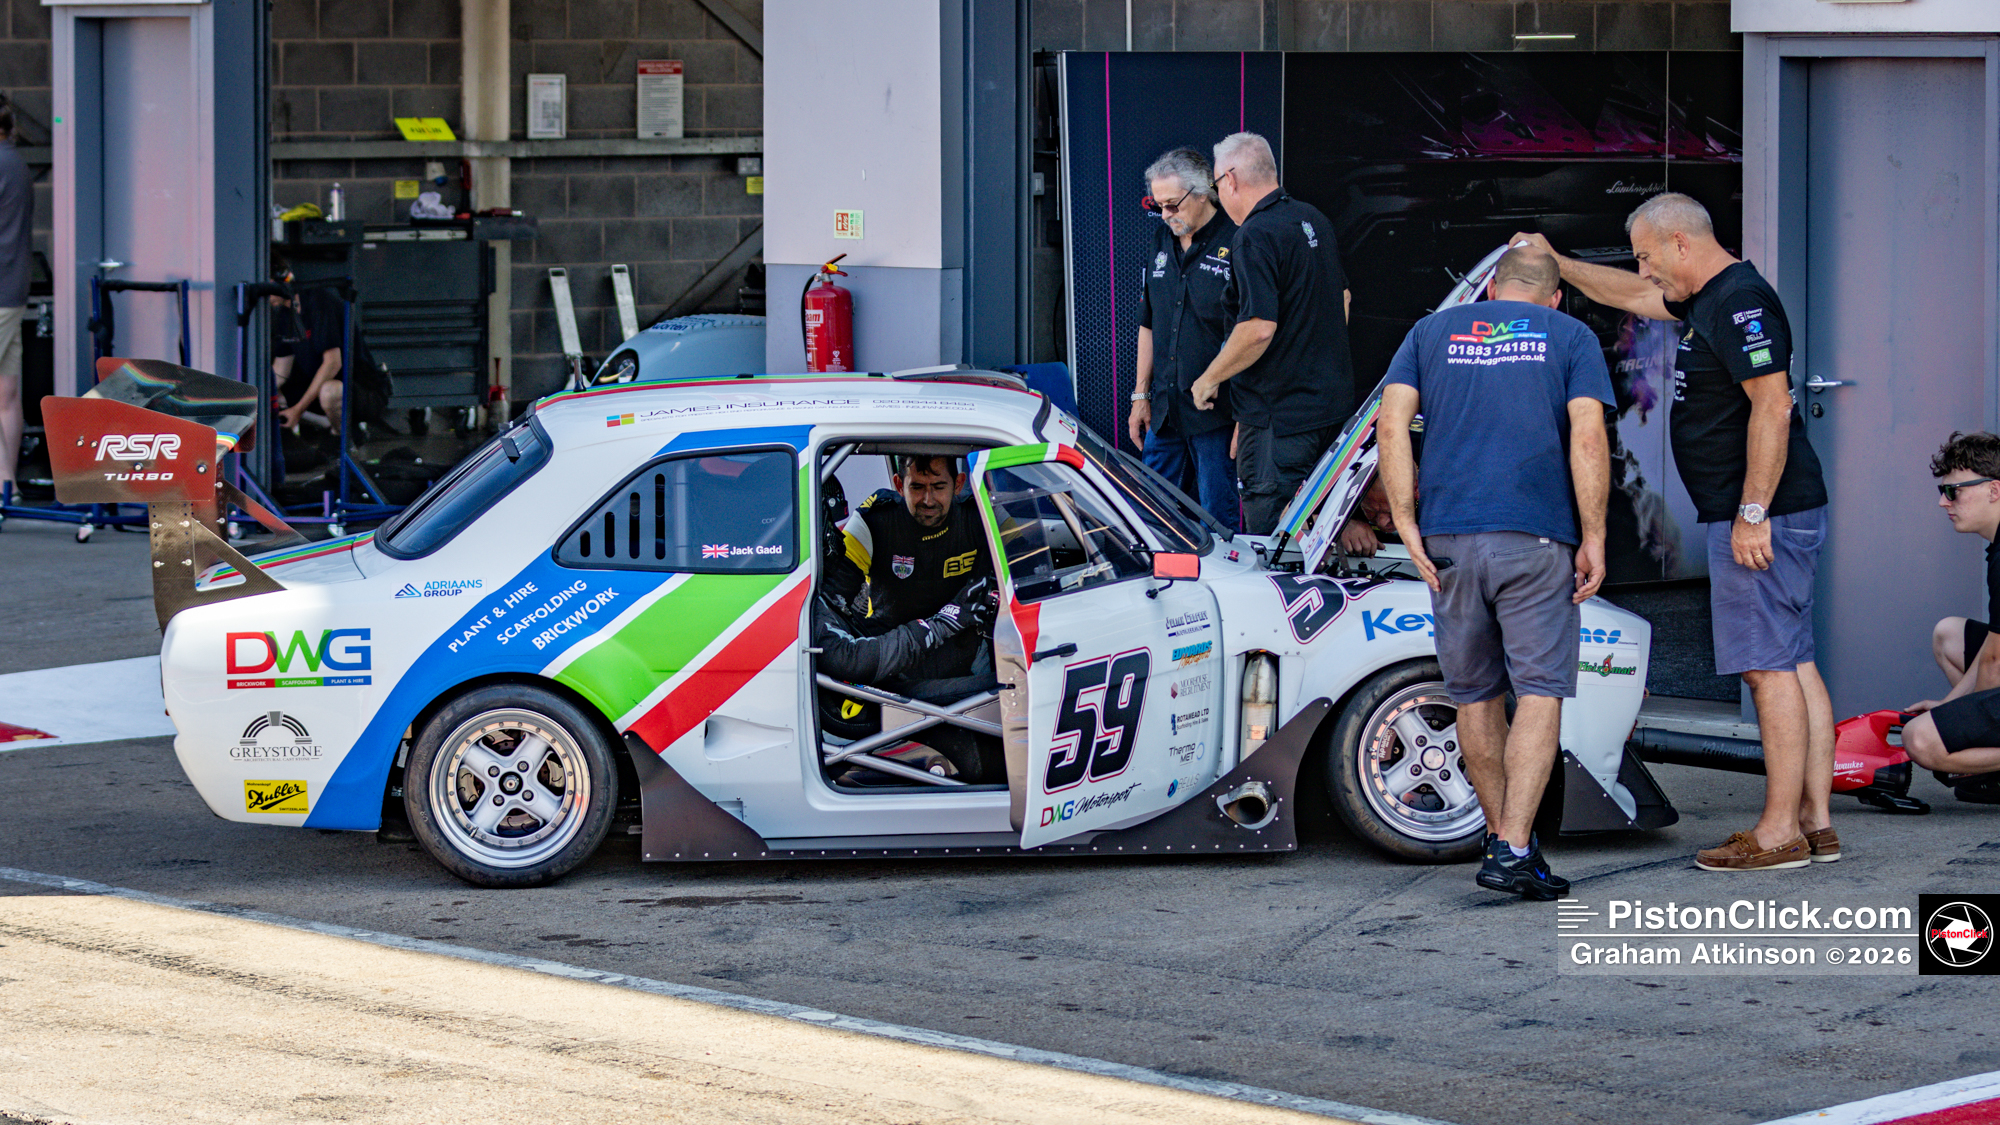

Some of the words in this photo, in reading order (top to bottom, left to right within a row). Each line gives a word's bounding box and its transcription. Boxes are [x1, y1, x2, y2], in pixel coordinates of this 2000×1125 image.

[805, 312, 820, 322] oam
[1472, 319, 1530, 336] DWG
[1448, 344, 1492, 356] 01883
[1494, 342, 1546, 354] 741818
[1448, 354, 1546, 366] www.dwggroup.co.uk
[640, 404, 720, 418] JAMES
[726, 399, 860, 410] INSURANCE
[95, 434, 181, 461] RSR
[104, 472, 174, 480] TURBO
[730, 546, 753, 555] Jack
[756, 545, 782, 554] Gadd
[424, 579, 482, 590] ADRIAANS
[424, 589, 462, 598] GROUP
[448, 615, 492, 653] PLANT
[492, 607, 507, 618] &
[504, 581, 538, 609] HIRE
[496, 580, 588, 645] SCAFFOLDING
[531, 587, 620, 650] BRICKWORK
[226, 628, 371, 674] DWG
[1172, 640, 1212, 662] EDWARDS
[1201, 708, 1209, 716] LTD
[1043, 646, 1152, 795] 59
[230, 746, 322, 758] GREYSTONE
[1169, 743, 1195, 756] Thermo
[1700, 740, 1763, 758] Milwauke
[1180, 752, 1194, 762] MET
[1834, 760, 1864, 771] lwaukee
[1040, 800, 1074, 828] DWG
[1074, 783, 1142, 816] Motorsport
